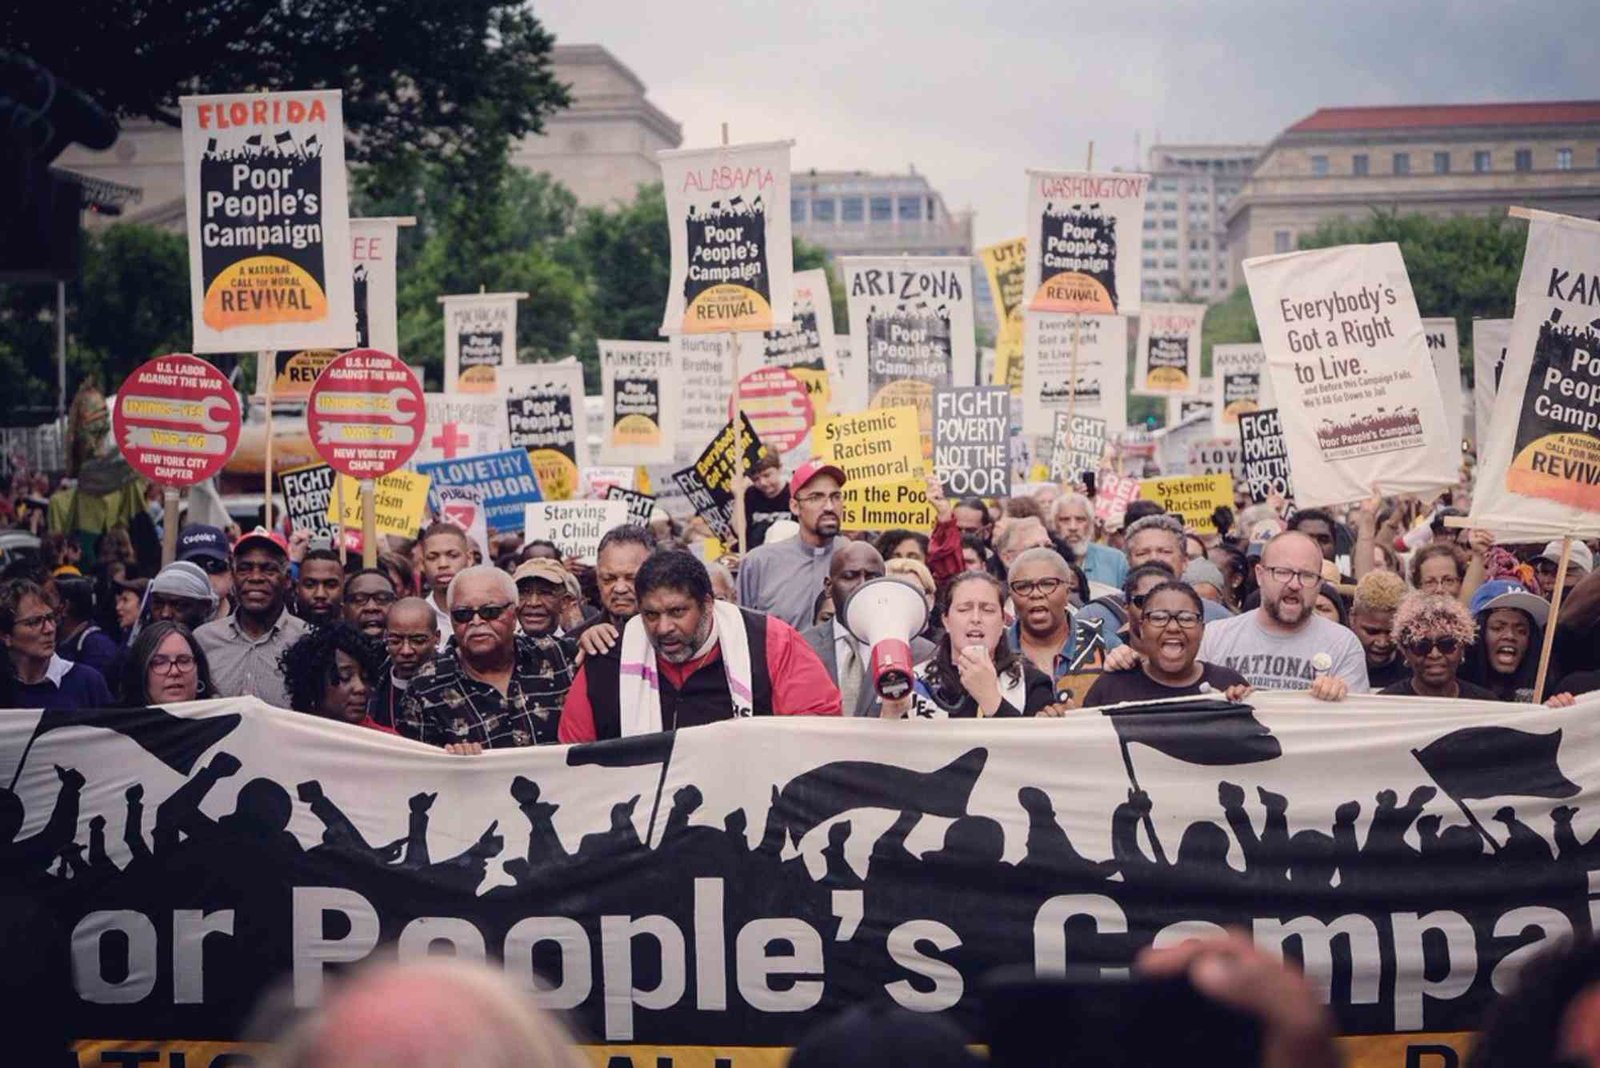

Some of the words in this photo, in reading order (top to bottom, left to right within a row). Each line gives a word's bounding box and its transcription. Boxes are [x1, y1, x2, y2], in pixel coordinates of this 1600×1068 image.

[198, 100, 326, 129] FLORIDA
[233, 164, 292, 190] Poor
[683, 166, 774, 192] ALABAMA
[1041, 176, 1141, 199] WASHINGTON
[207, 189, 318, 222] People's
[203, 220, 322, 250] Campaign
[704, 226, 743, 243] Poor
[1062, 222, 1097, 239] Poor
[692, 241, 758, 264] People's
[1048, 236, 1109, 257] People's
[690, 261, 762, 282] Campaign
[1044, 253, 1109, 273] Campaign
[852, 269, 962, 300] ARIZONA
[1046, 286, 1100, 302] REVIVAL
[221, 288, 311, 312] REVIVAL
[1280, 283, 1396, 322] Everybody's
[697, 301, 757, 320] REVIVAL
[890, 325, 926, 342] Poor
[1288, 328, 1322, 353] Got
[1325, 330, 1338, 347] a
[1341, 316, 1394, 348] Right
[605, 351, 671, 368] MINNESOTA
[877, 340, 943, 361] People's
[156, 362, 173, 374] U.S.
[175, 364, 206, 377] LABOR
[345, 357, 364, 368] U.S.
[366, 358, 392, 369] LABOR
[875, 360, 947, 377] Campaign
[1295, 362, 1314, 384] to
[1319, 355, 1368, 380] Live.
[138, 373, 177, 386] AGAINST
[179, 376, 197, 388] THE
[199, 378, 222, 390] WAR
[330, 368, 368, 380] AGAINST
[369, 370, 384, 381] THE
[386, 371, 407, 382] WAR
[522, 399, 556, 415] Poor
[937, 391, 1007, 417] FIGHT
[1535, 395, 1600, 432] Camp
[510, 412, 573, 430] People's
[825, 412, 897, 440] Systemic
[937, 417, 1007, 442] POVERTY
[1056, 412, 1105, 438] FGHT
[1320, 436, 1340, 448] Poor
[1341, 431, 1378, 444] People's
[1379, 424, 1422, 438] Campaign
[333, 448, 355, 459] NEW
[357, 449, 376, 460] YORK
[376, 450, 397, 460] CITY
[833, 438, 892, 460] Racism
[936, 446, 971, 470] NOT
[971, 445, 1006, 467] THE
[140, 453, 162, 464] NEW
[163, 455, 186, 467] YORK
[186, 457, 209, 469] CITY
[349, 460, 384, 471] CHAPTER
[155, 466, 193, 480] CHAPTER
[284, 467, 332, 497] FIGHT
[377, 474, 413, 491] temic
[937, 469, 1006, 495] POOR
[440, 488, 480, 505] PUBLIC
[865, 486, 890, 500] the
[1157, 479, 1217, 497] Systemic
[544, 503, 606, 521] Starving
[842, 506, 856, 524] is
[1164, 499, 1212, 513] Racism
[548, 528, 557, 540] a
[562, 522, 600, 539] Child
[70, 908, 235, 1005] or
